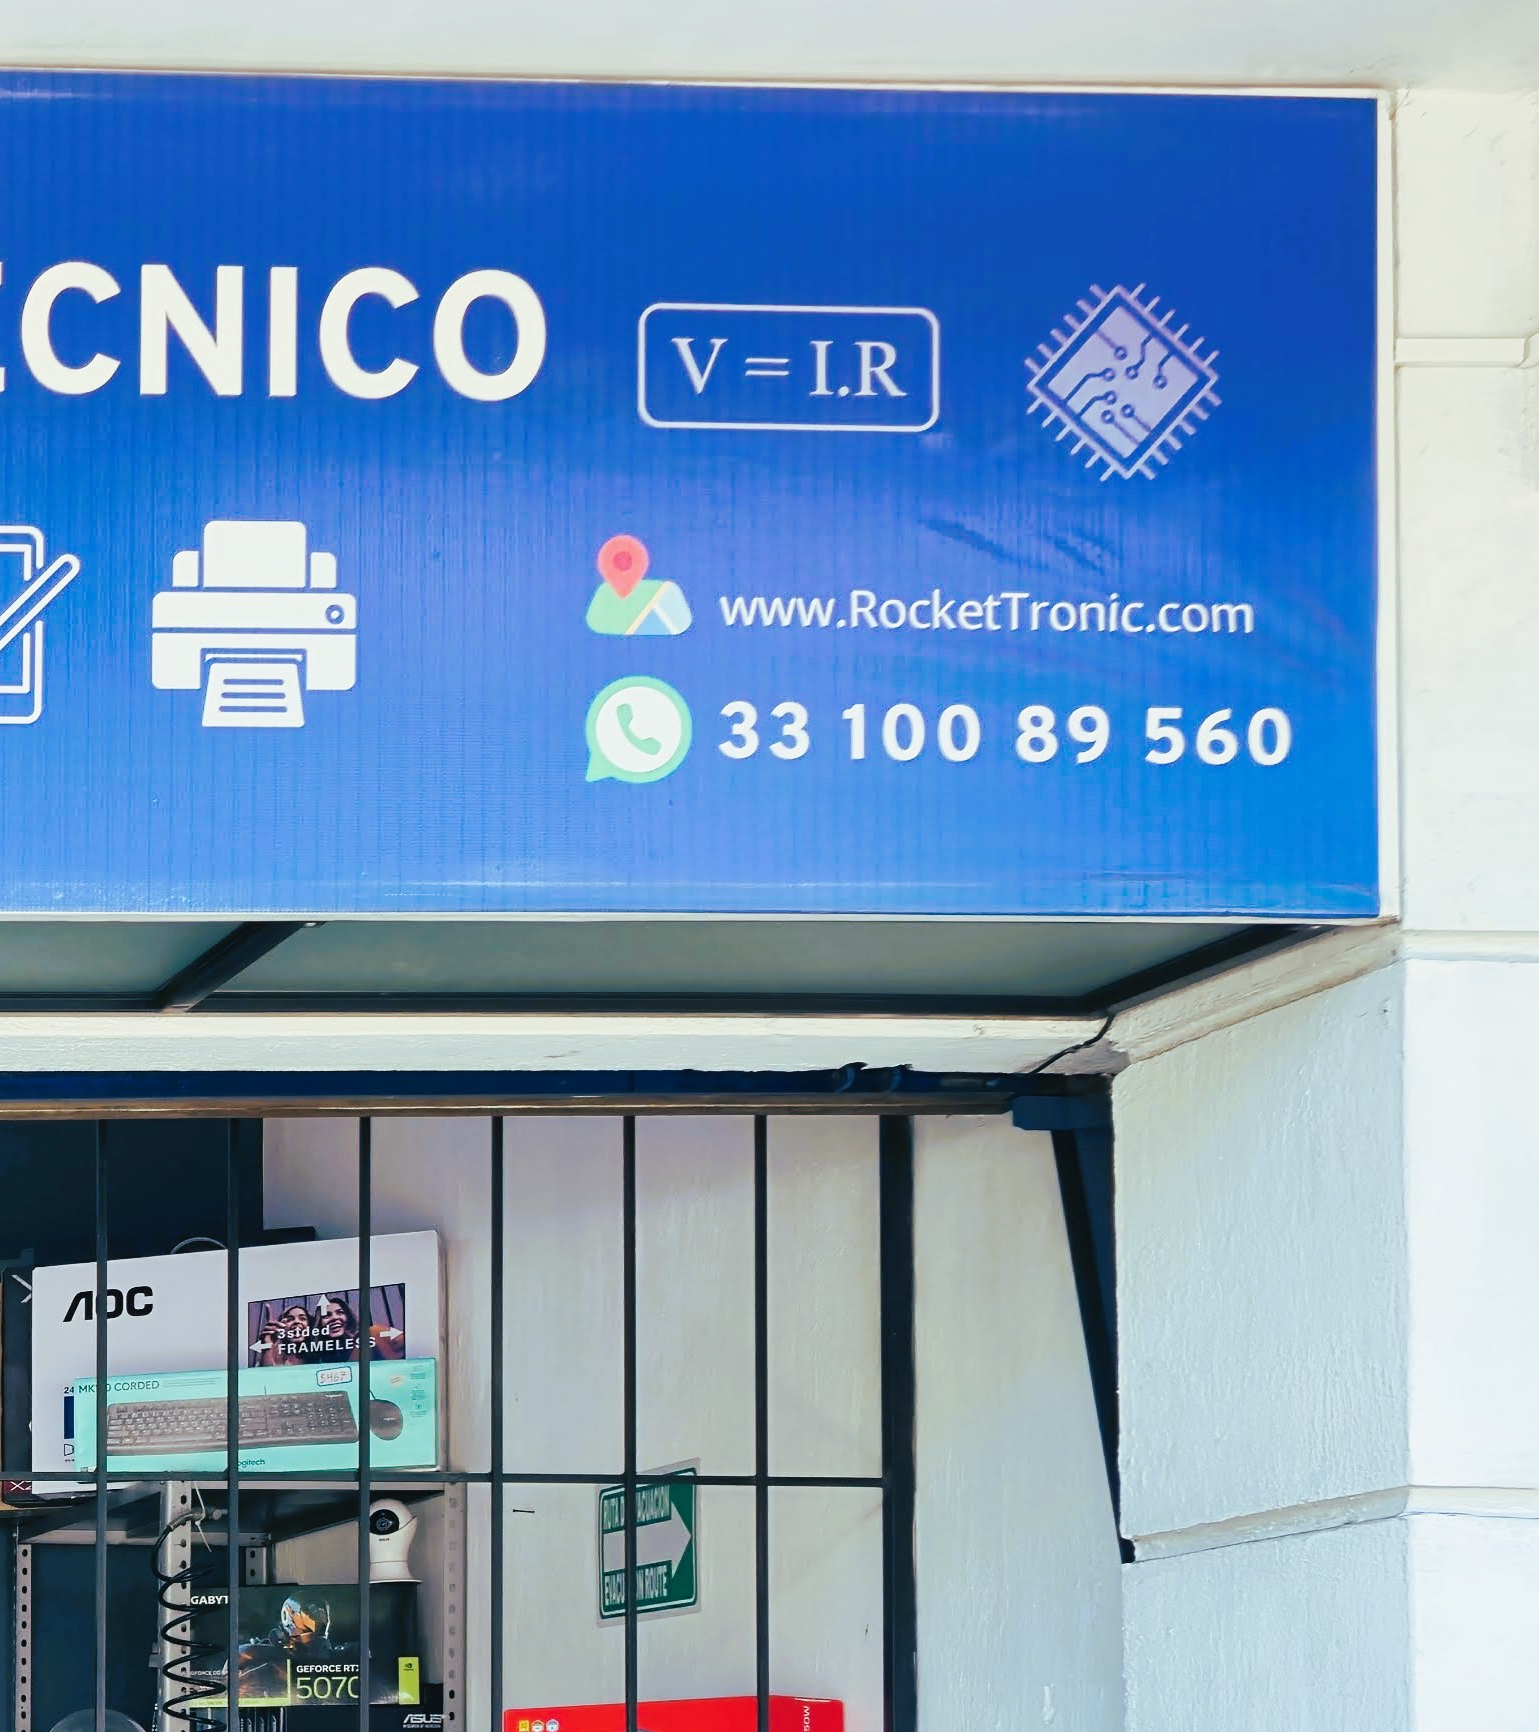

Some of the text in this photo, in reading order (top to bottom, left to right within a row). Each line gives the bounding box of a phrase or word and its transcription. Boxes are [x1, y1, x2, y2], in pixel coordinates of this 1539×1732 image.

[673, 337, 728, 395] V
[810, 339, 907, 398] I.R
[720, 588, 1255, 635] www.RocketTronic.com
[718, 701, 1294, 768] 33 100 89 560
[63, 1286, 154, 1322] AOC
[277, 1324, 330, 1340] 3sided
[278, 1336, 376, 1355] FRAMELESS
[114, 1380, 160, 1392] CORDED
[237, 1458, 266, 1469] ogitech
[190, 1595, 229, 1605] GABYT
[296, 1664, 342, 1674] GEFORCE
[295, 1676, 360, 1700] 5070
[402, 1713, 444, 1725] ASUS
